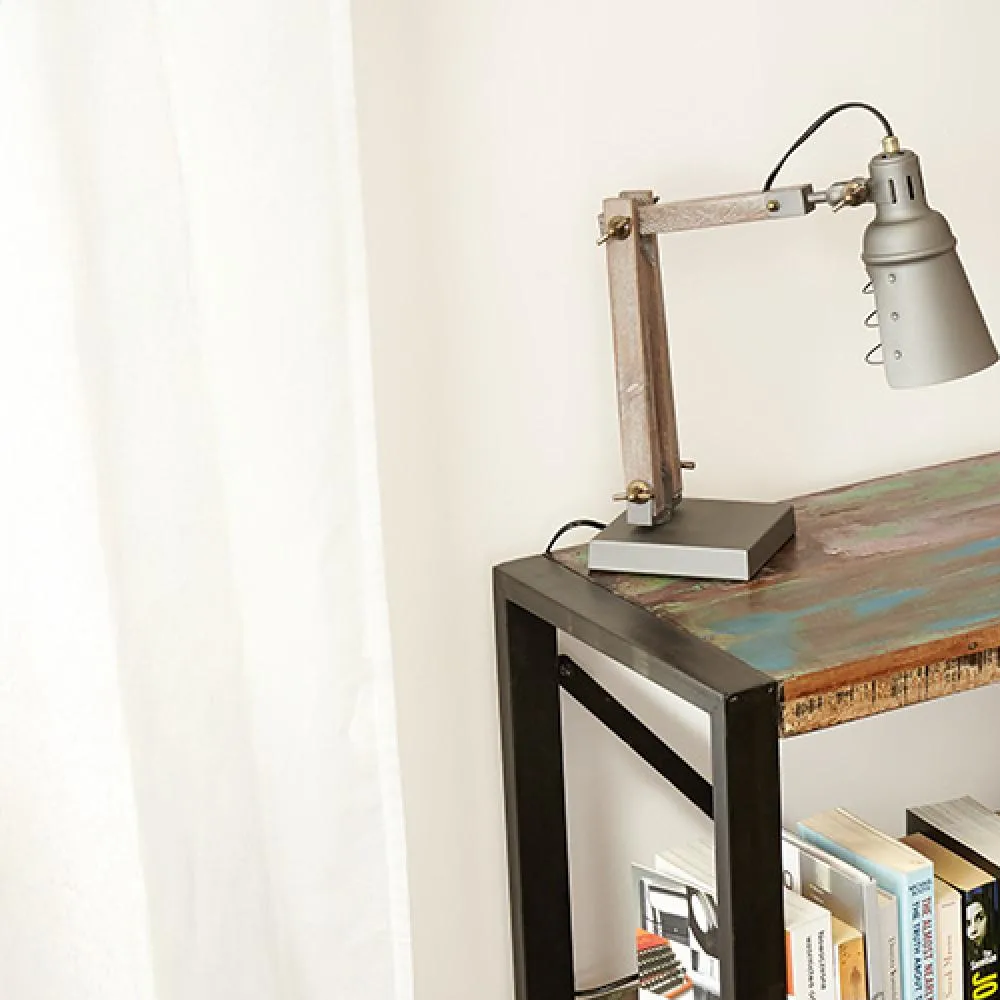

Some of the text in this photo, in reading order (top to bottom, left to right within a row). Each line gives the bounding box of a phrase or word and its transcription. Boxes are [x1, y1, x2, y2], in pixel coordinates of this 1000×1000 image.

[922, 896, 933, 918] THE
[923, 919, 935, 961] ALMOST
[914, 957, 924, 992] ABOUT
[971, 971, 999, 1000] JO
